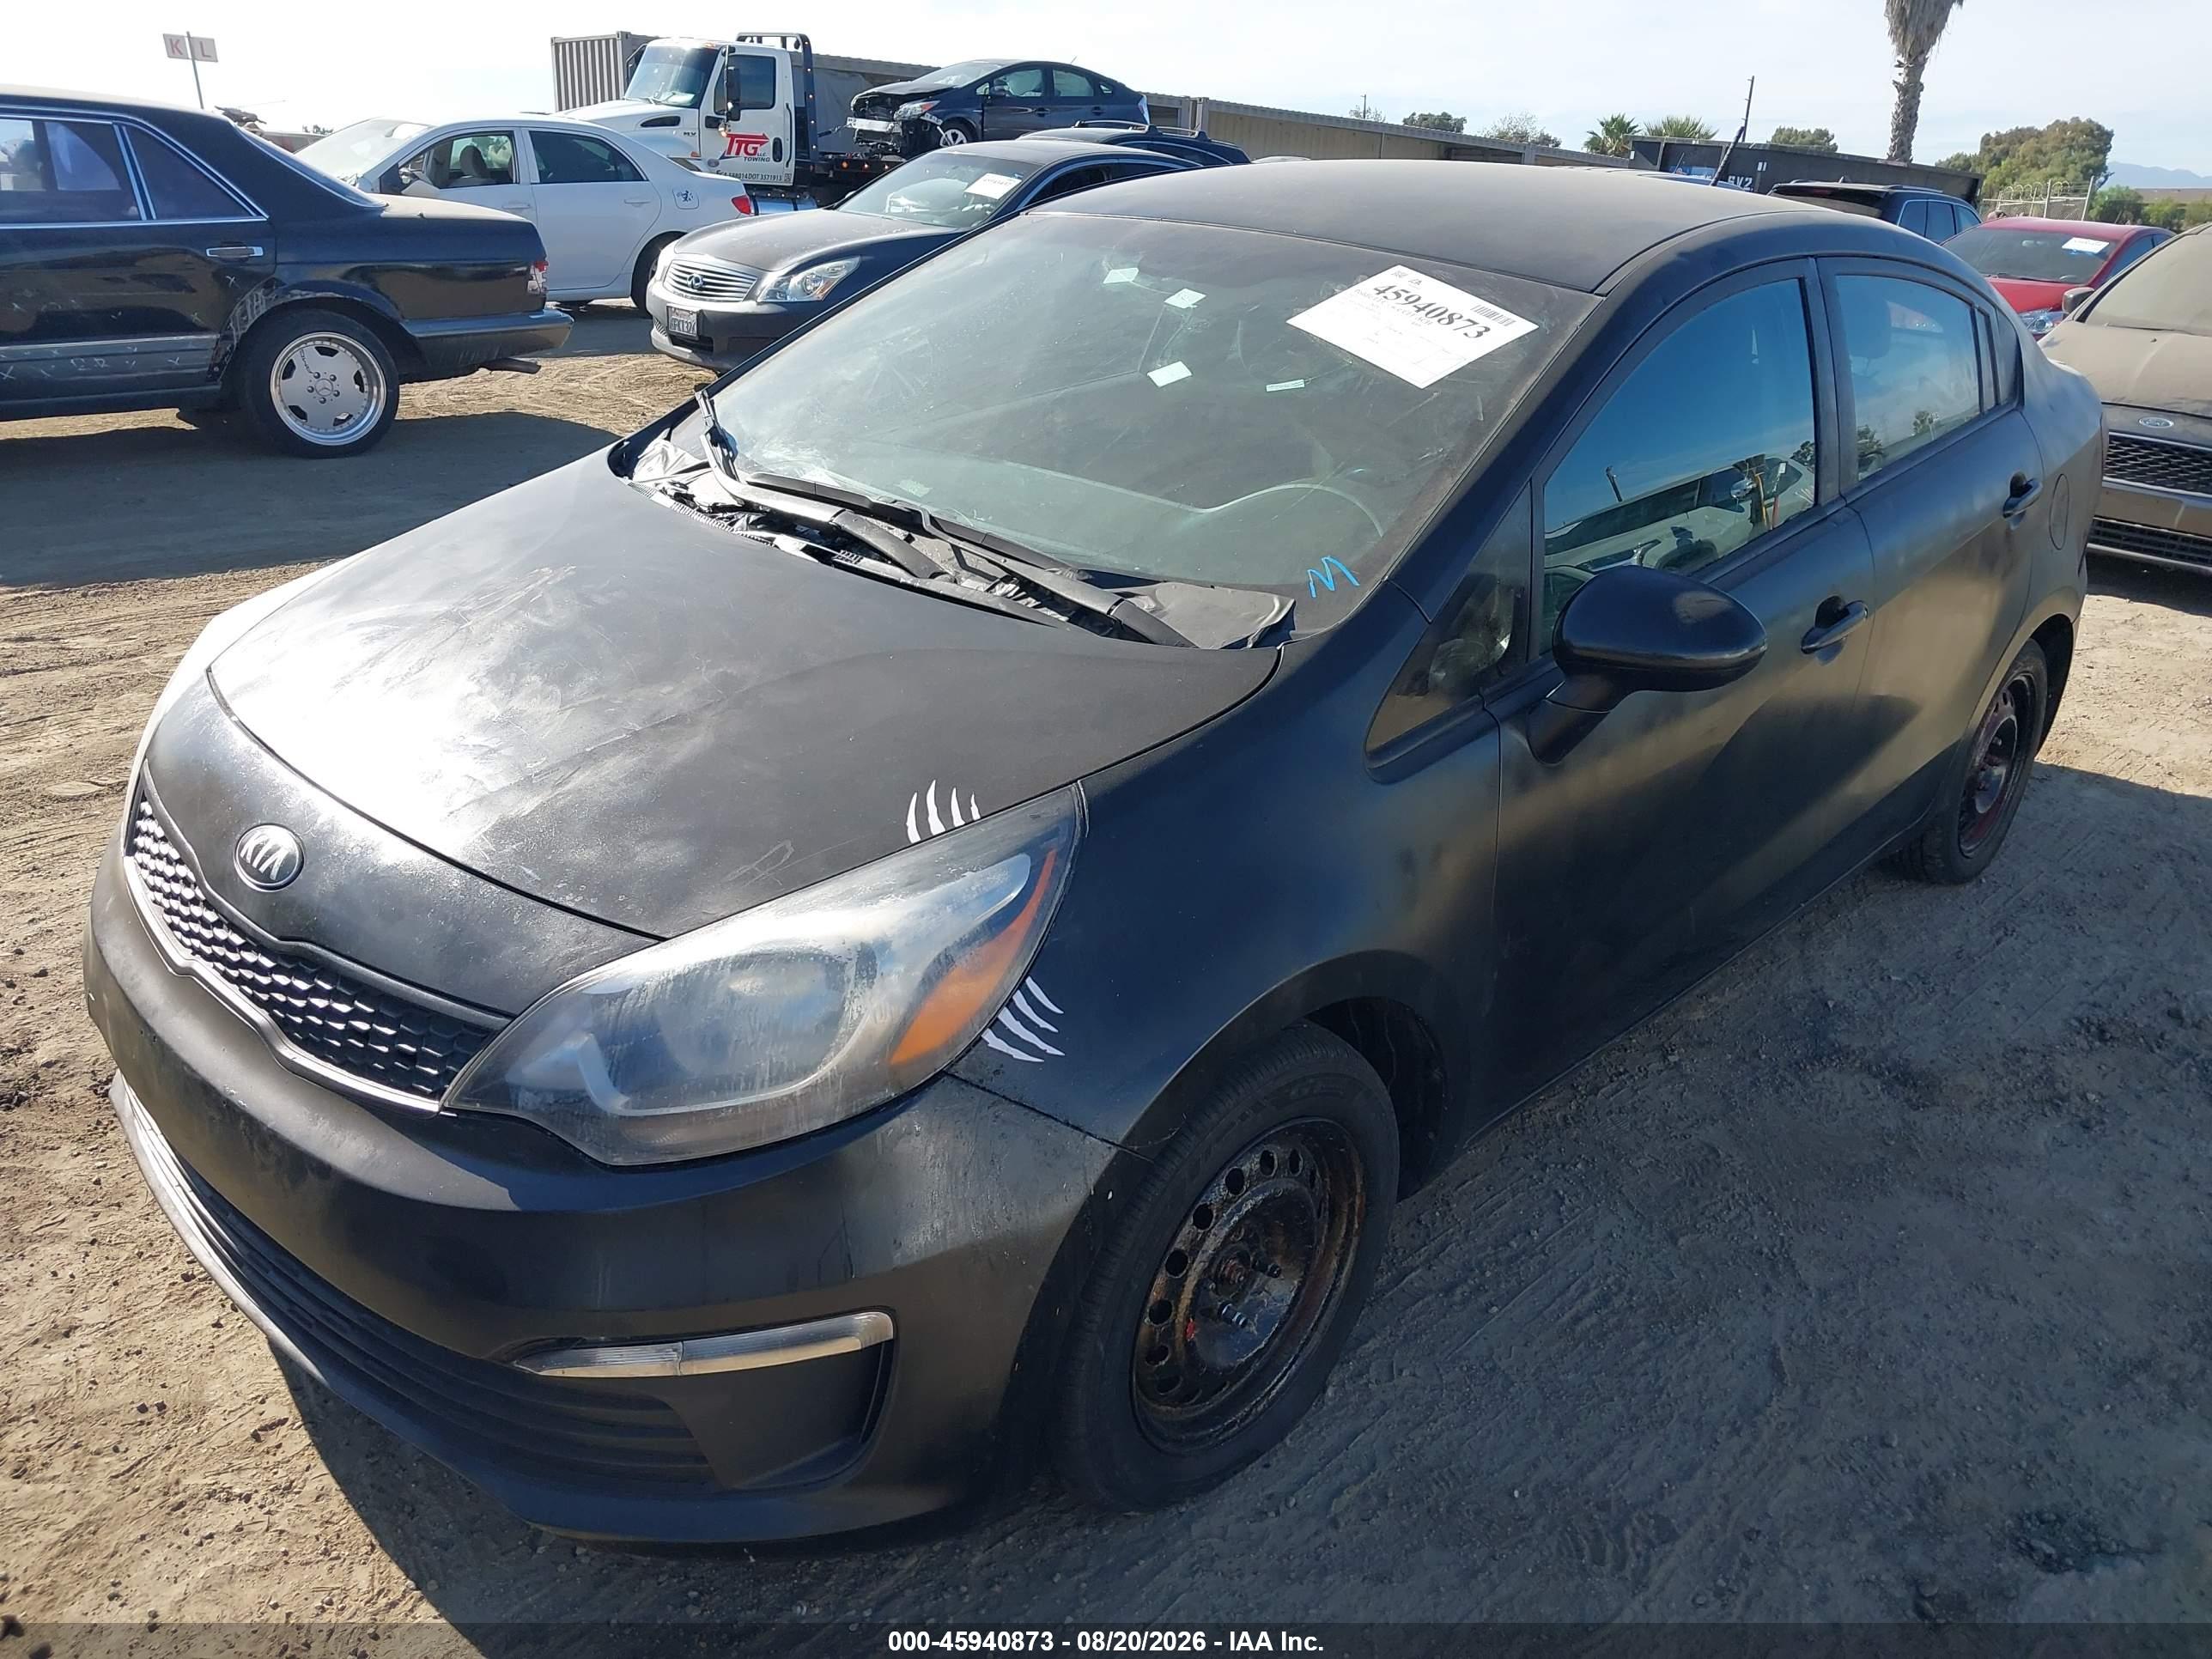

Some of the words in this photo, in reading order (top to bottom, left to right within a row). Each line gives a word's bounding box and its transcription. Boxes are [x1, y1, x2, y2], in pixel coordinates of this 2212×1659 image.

[169, 38, 184, 56] K
[199, 40, 212, 58] L
[1373, 285, 1491, 338] 45940873
